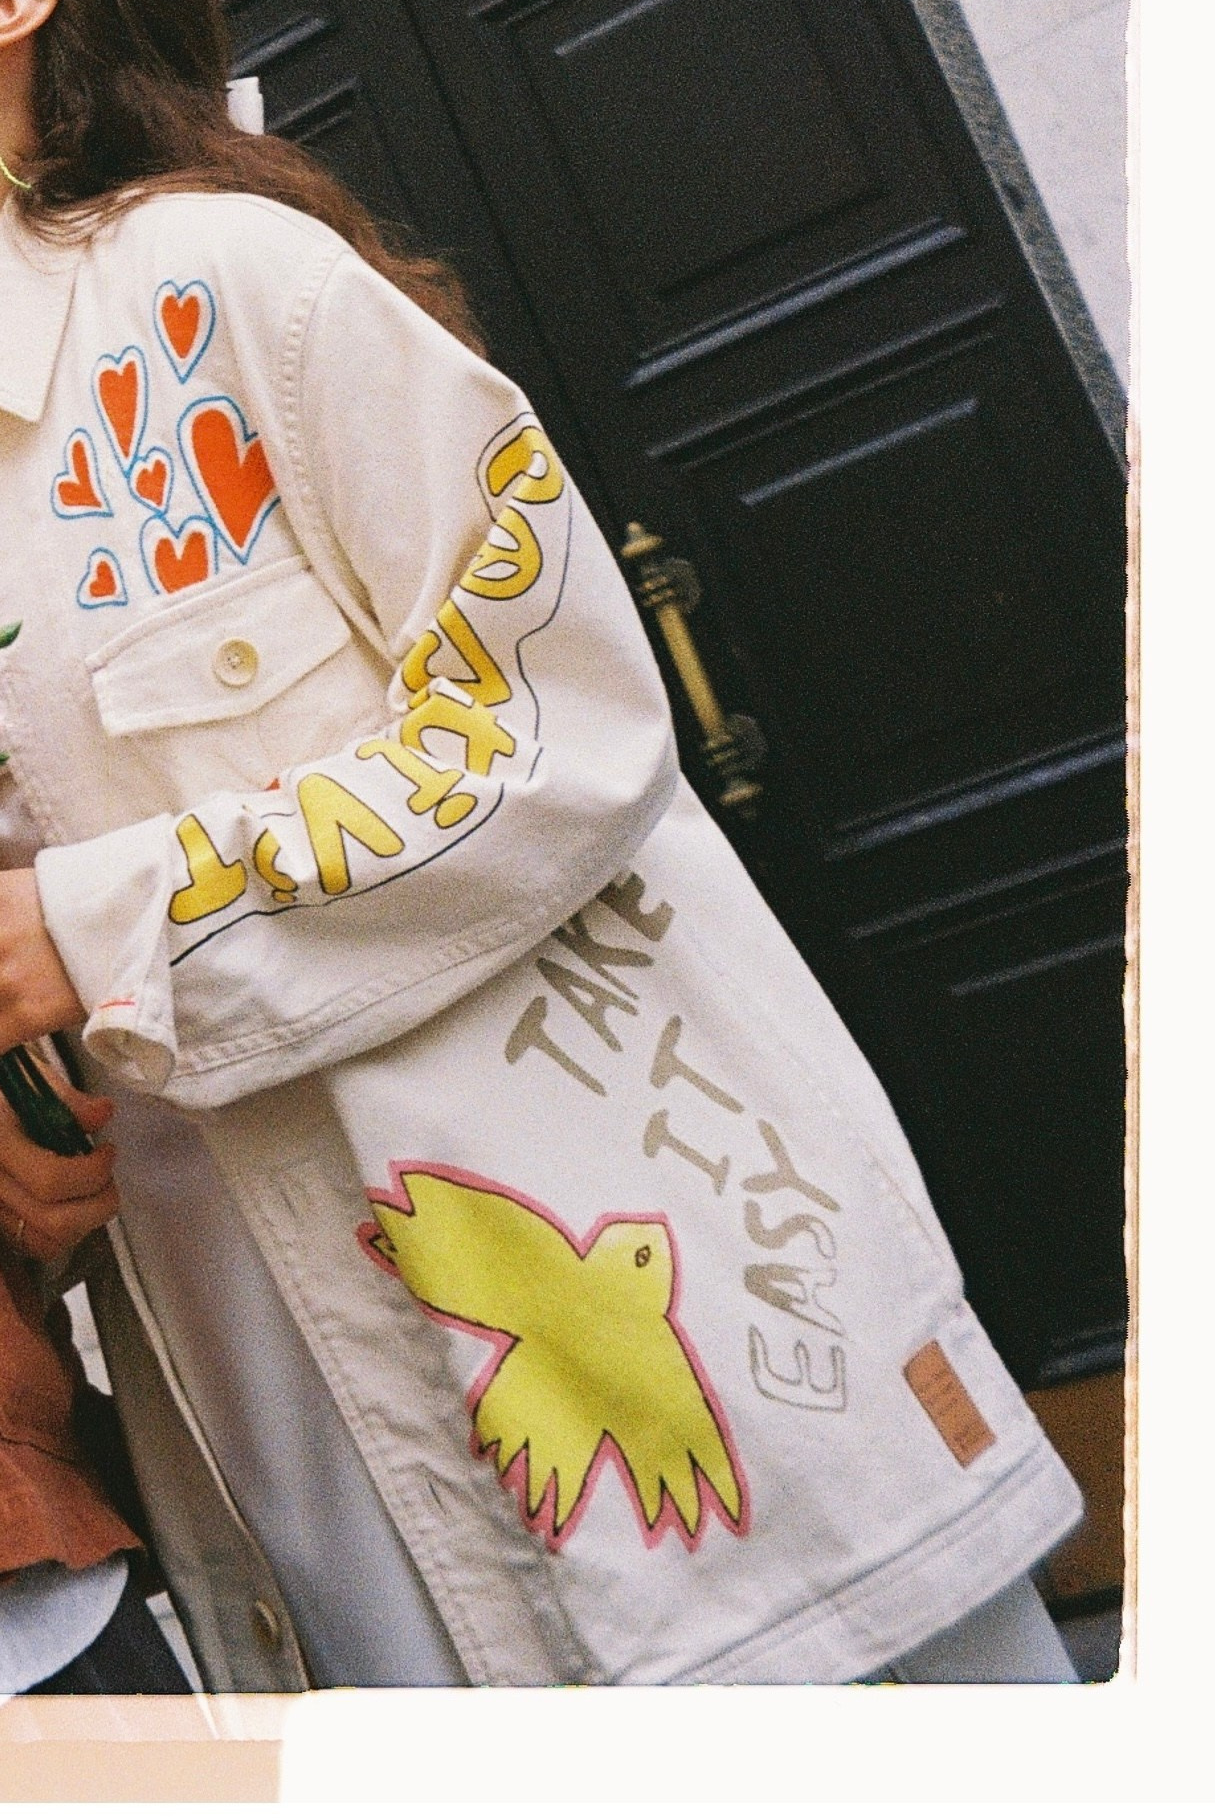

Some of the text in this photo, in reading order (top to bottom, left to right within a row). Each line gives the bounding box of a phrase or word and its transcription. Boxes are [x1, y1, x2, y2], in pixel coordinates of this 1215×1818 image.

[504, 871, 676, 1098] TAKE
[642, 1014, 746, 1197] IT
[739, 1117, 848, 1412] EASY
